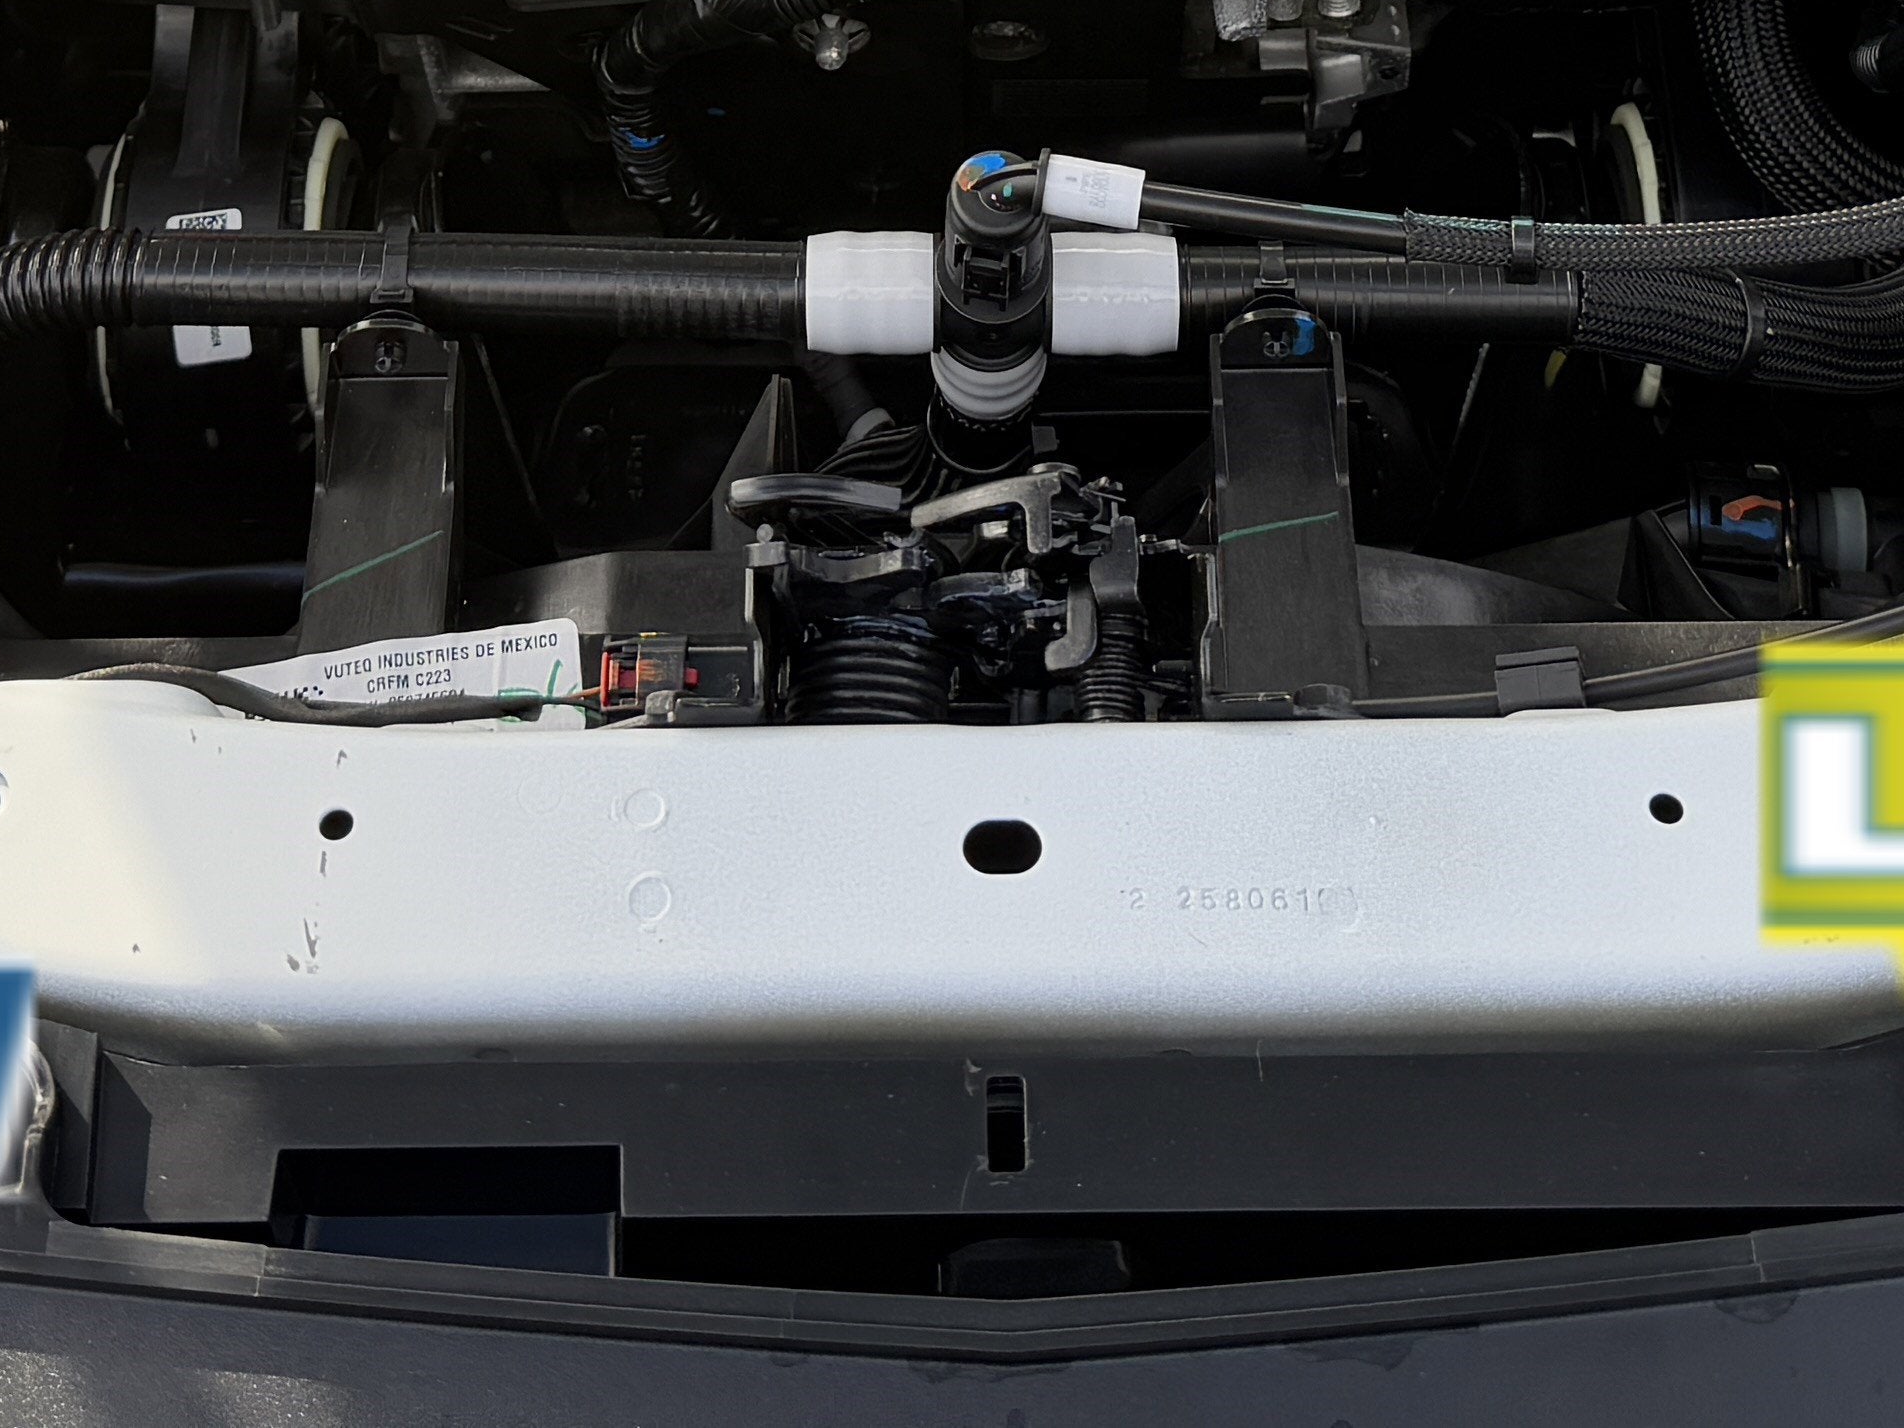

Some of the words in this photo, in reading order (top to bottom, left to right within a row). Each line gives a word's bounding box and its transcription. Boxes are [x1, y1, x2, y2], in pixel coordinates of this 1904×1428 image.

[377, 645, 470, 670] INDUSTRIES
[475, 642, 495, 658] DE
[500, 632, 559, 655] MEXICO
[366, 675, 411, 694] CRFM
[415, 667, 453, 687] C223
